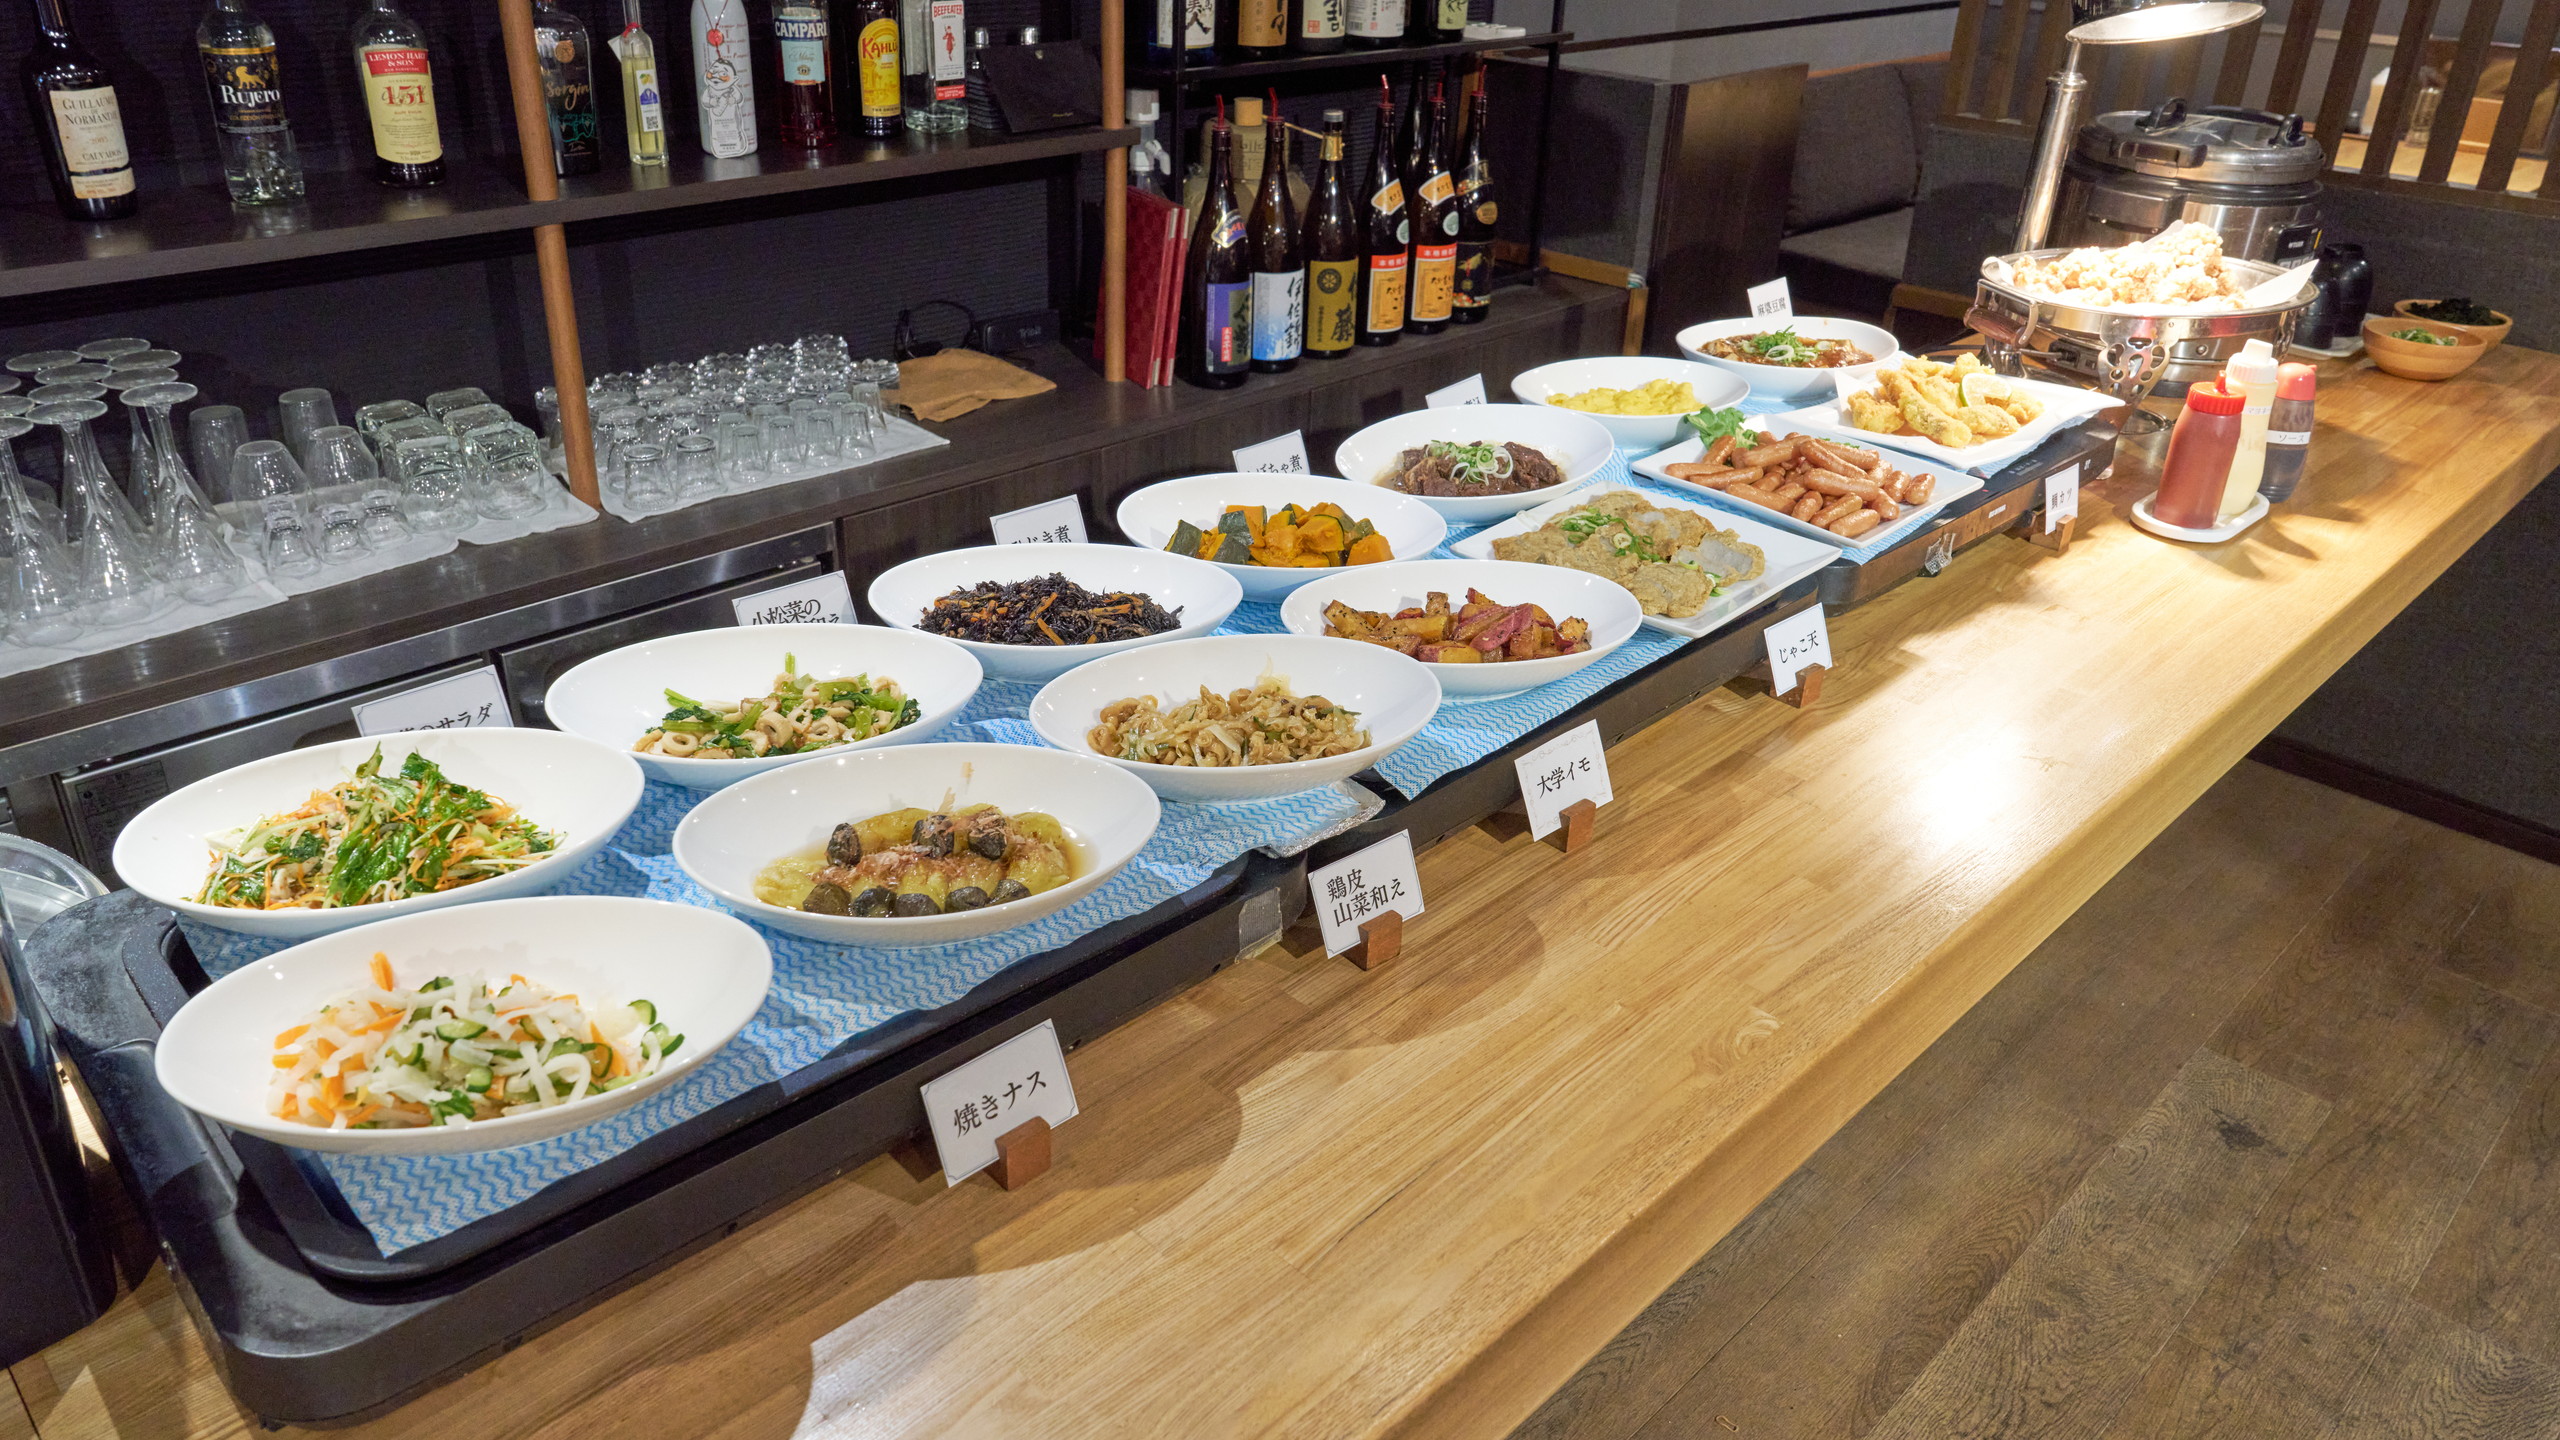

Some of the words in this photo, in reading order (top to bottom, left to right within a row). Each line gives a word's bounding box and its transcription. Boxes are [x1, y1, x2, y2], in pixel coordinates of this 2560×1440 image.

[934, 4, 963, 17] BEEFEATER
[775, 21, 828, 38] CAMPARI
[369, 52, 405, 62] LEMON
[220, 84, 281, 107] Rujero
[384, 85, 426, 105] 151
[546, 83, 590, 110] Sorgin
[82, 150, 122, 161] CALVADOS
[2279, 434, 2305, 443] ソース
[1246, 454, 1303, 473] ちゃ煮
[1011, 524, 1072, 544] き煮
[1778, 630, 1819, 664] じゃこ天
[400, 702, 493, 732] サラダ
[1536, 757, 1591, 799] 大学イモ
[1325, 868, 1366, 903] 鶏皮
[1333, 878, 1406, 928] 山菜和え
[953, 1070, 1047, 1138] 焼きナス
